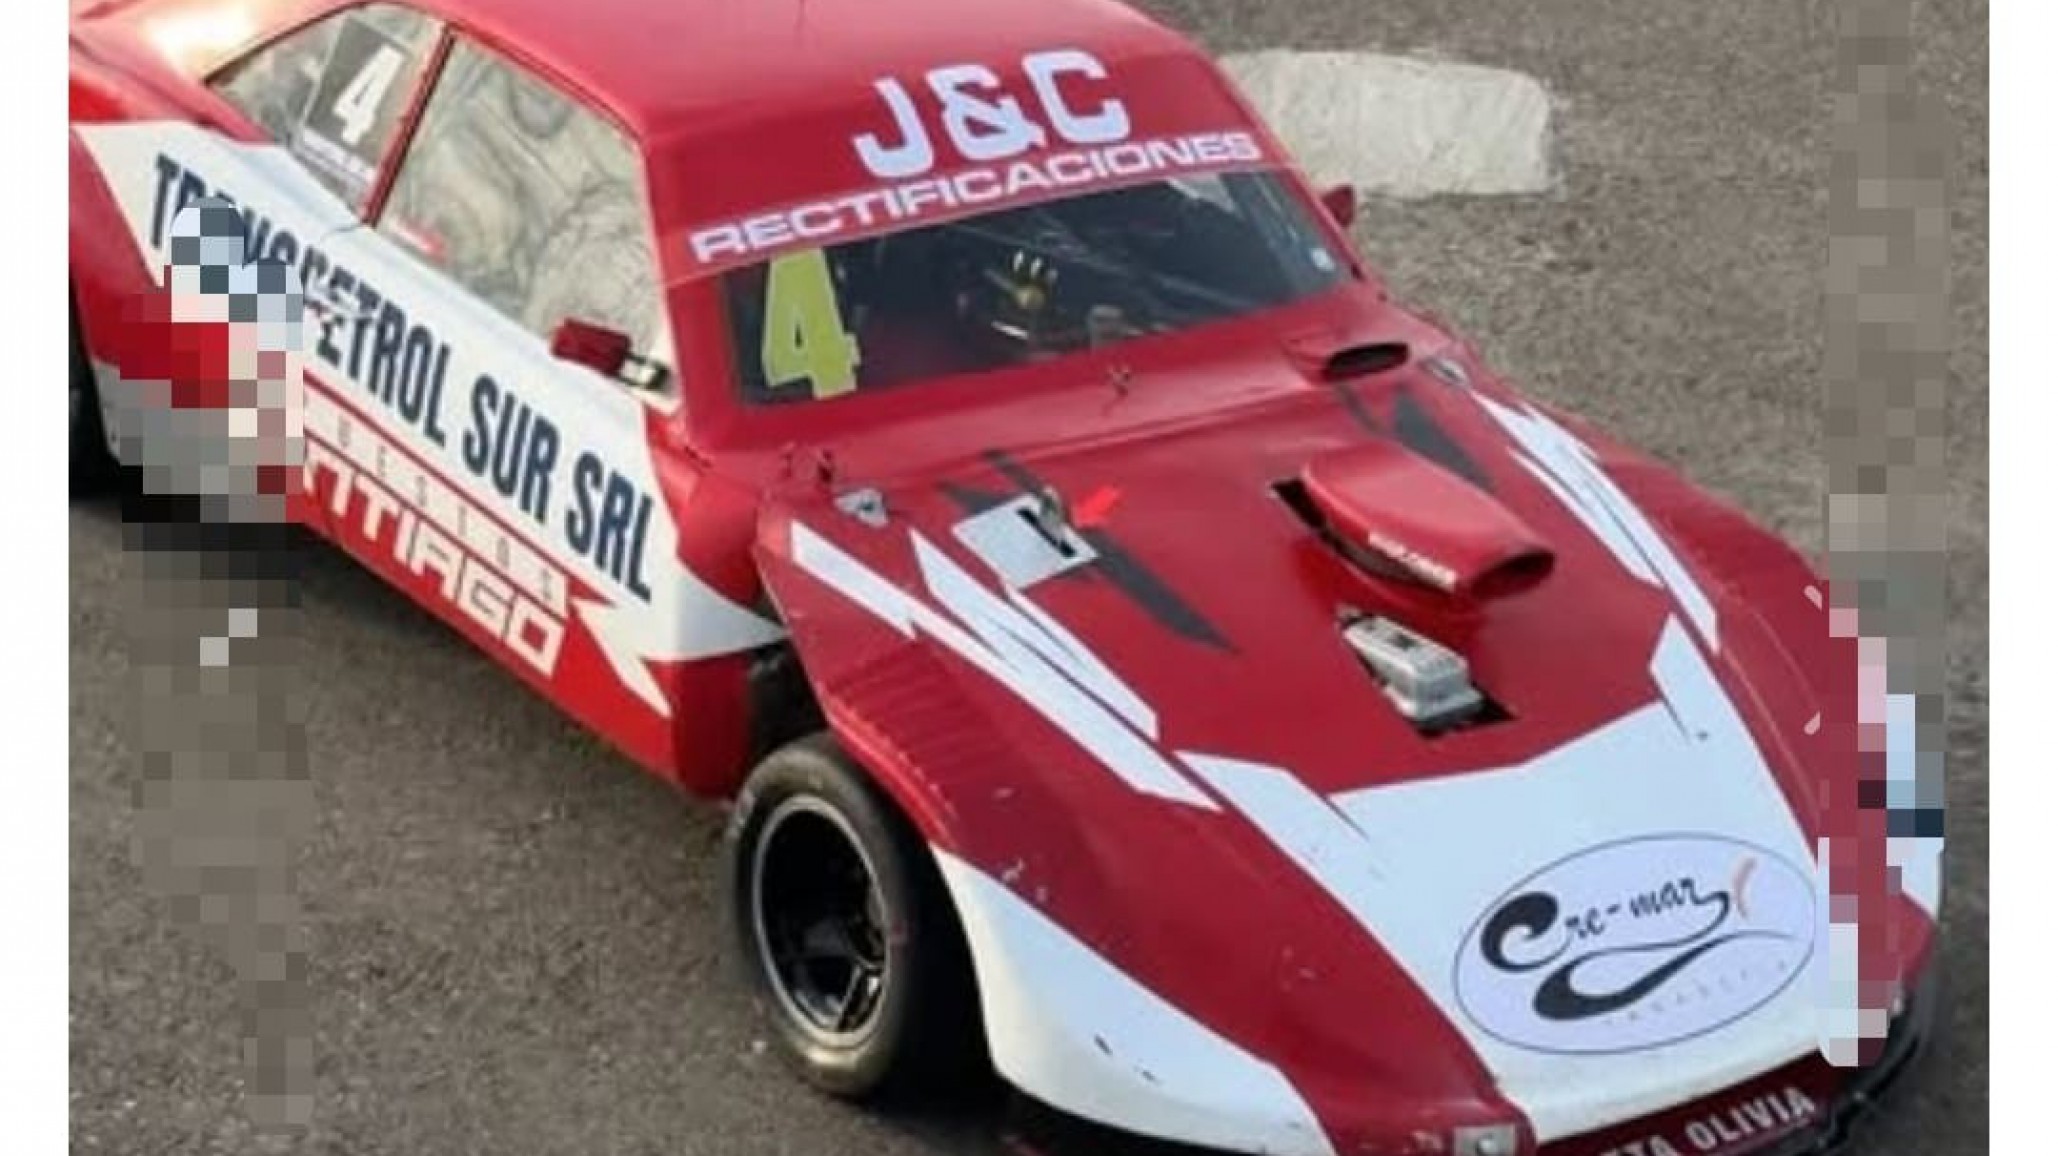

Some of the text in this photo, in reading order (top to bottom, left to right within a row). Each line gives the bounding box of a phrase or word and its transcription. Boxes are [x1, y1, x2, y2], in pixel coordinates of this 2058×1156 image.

[333, 45, 404, 143] 4
[854, 49, 1130, 178] J&C
[689, 131, 1262, 263] RECTIFICACIONES
[761, 248, 861, 400] 4
[462, 373, 561, 525] SUR
[565, 450, 654, 604] SRL
[1684, 1085, 1816, 1150] OLIVIA
